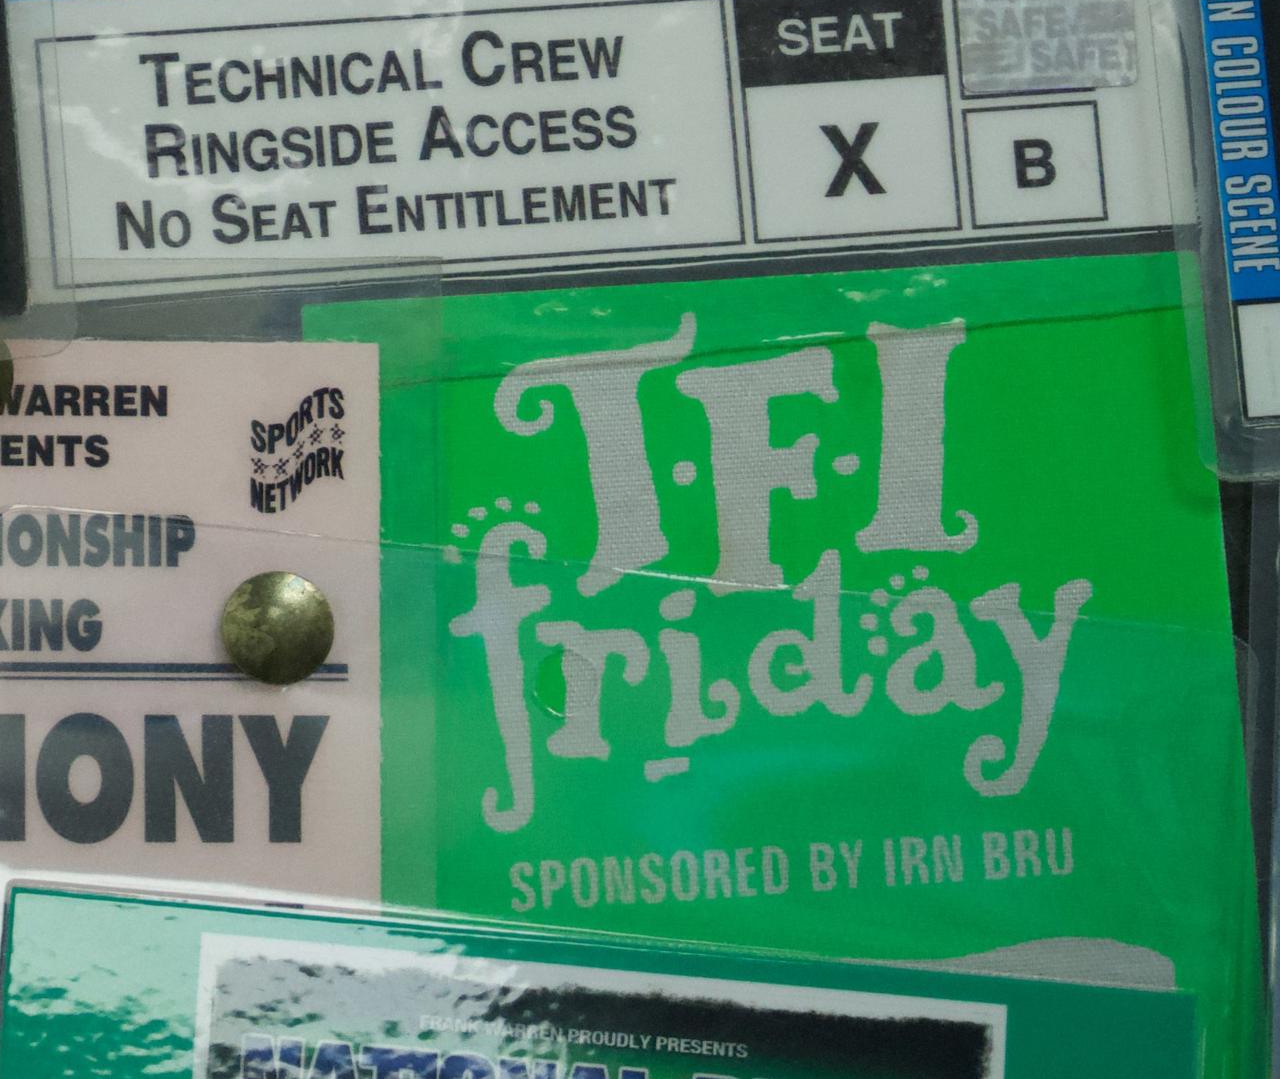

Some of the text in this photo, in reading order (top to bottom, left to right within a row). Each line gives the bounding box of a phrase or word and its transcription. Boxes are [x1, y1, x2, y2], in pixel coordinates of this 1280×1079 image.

[777, 13, 903, 58] SEAT
[1210, 35, 1269, 161] COLOUR
[822, 122, 887, 199] X
[1013, 139, 1057, 189] B
[1224, 174, 1280, 273] SCENE
[250, 387, 345, 454] SPORTS
[250, 445, 344, 513] NETWORK
[448, 522, 1094, 833] friday
[509, 827, 1076, 913] SPONSORED BY IRN BRU
[568, 1029, 651, 1050] PROUDLY
[655, 1036, 749, 1059] PRESENTS
